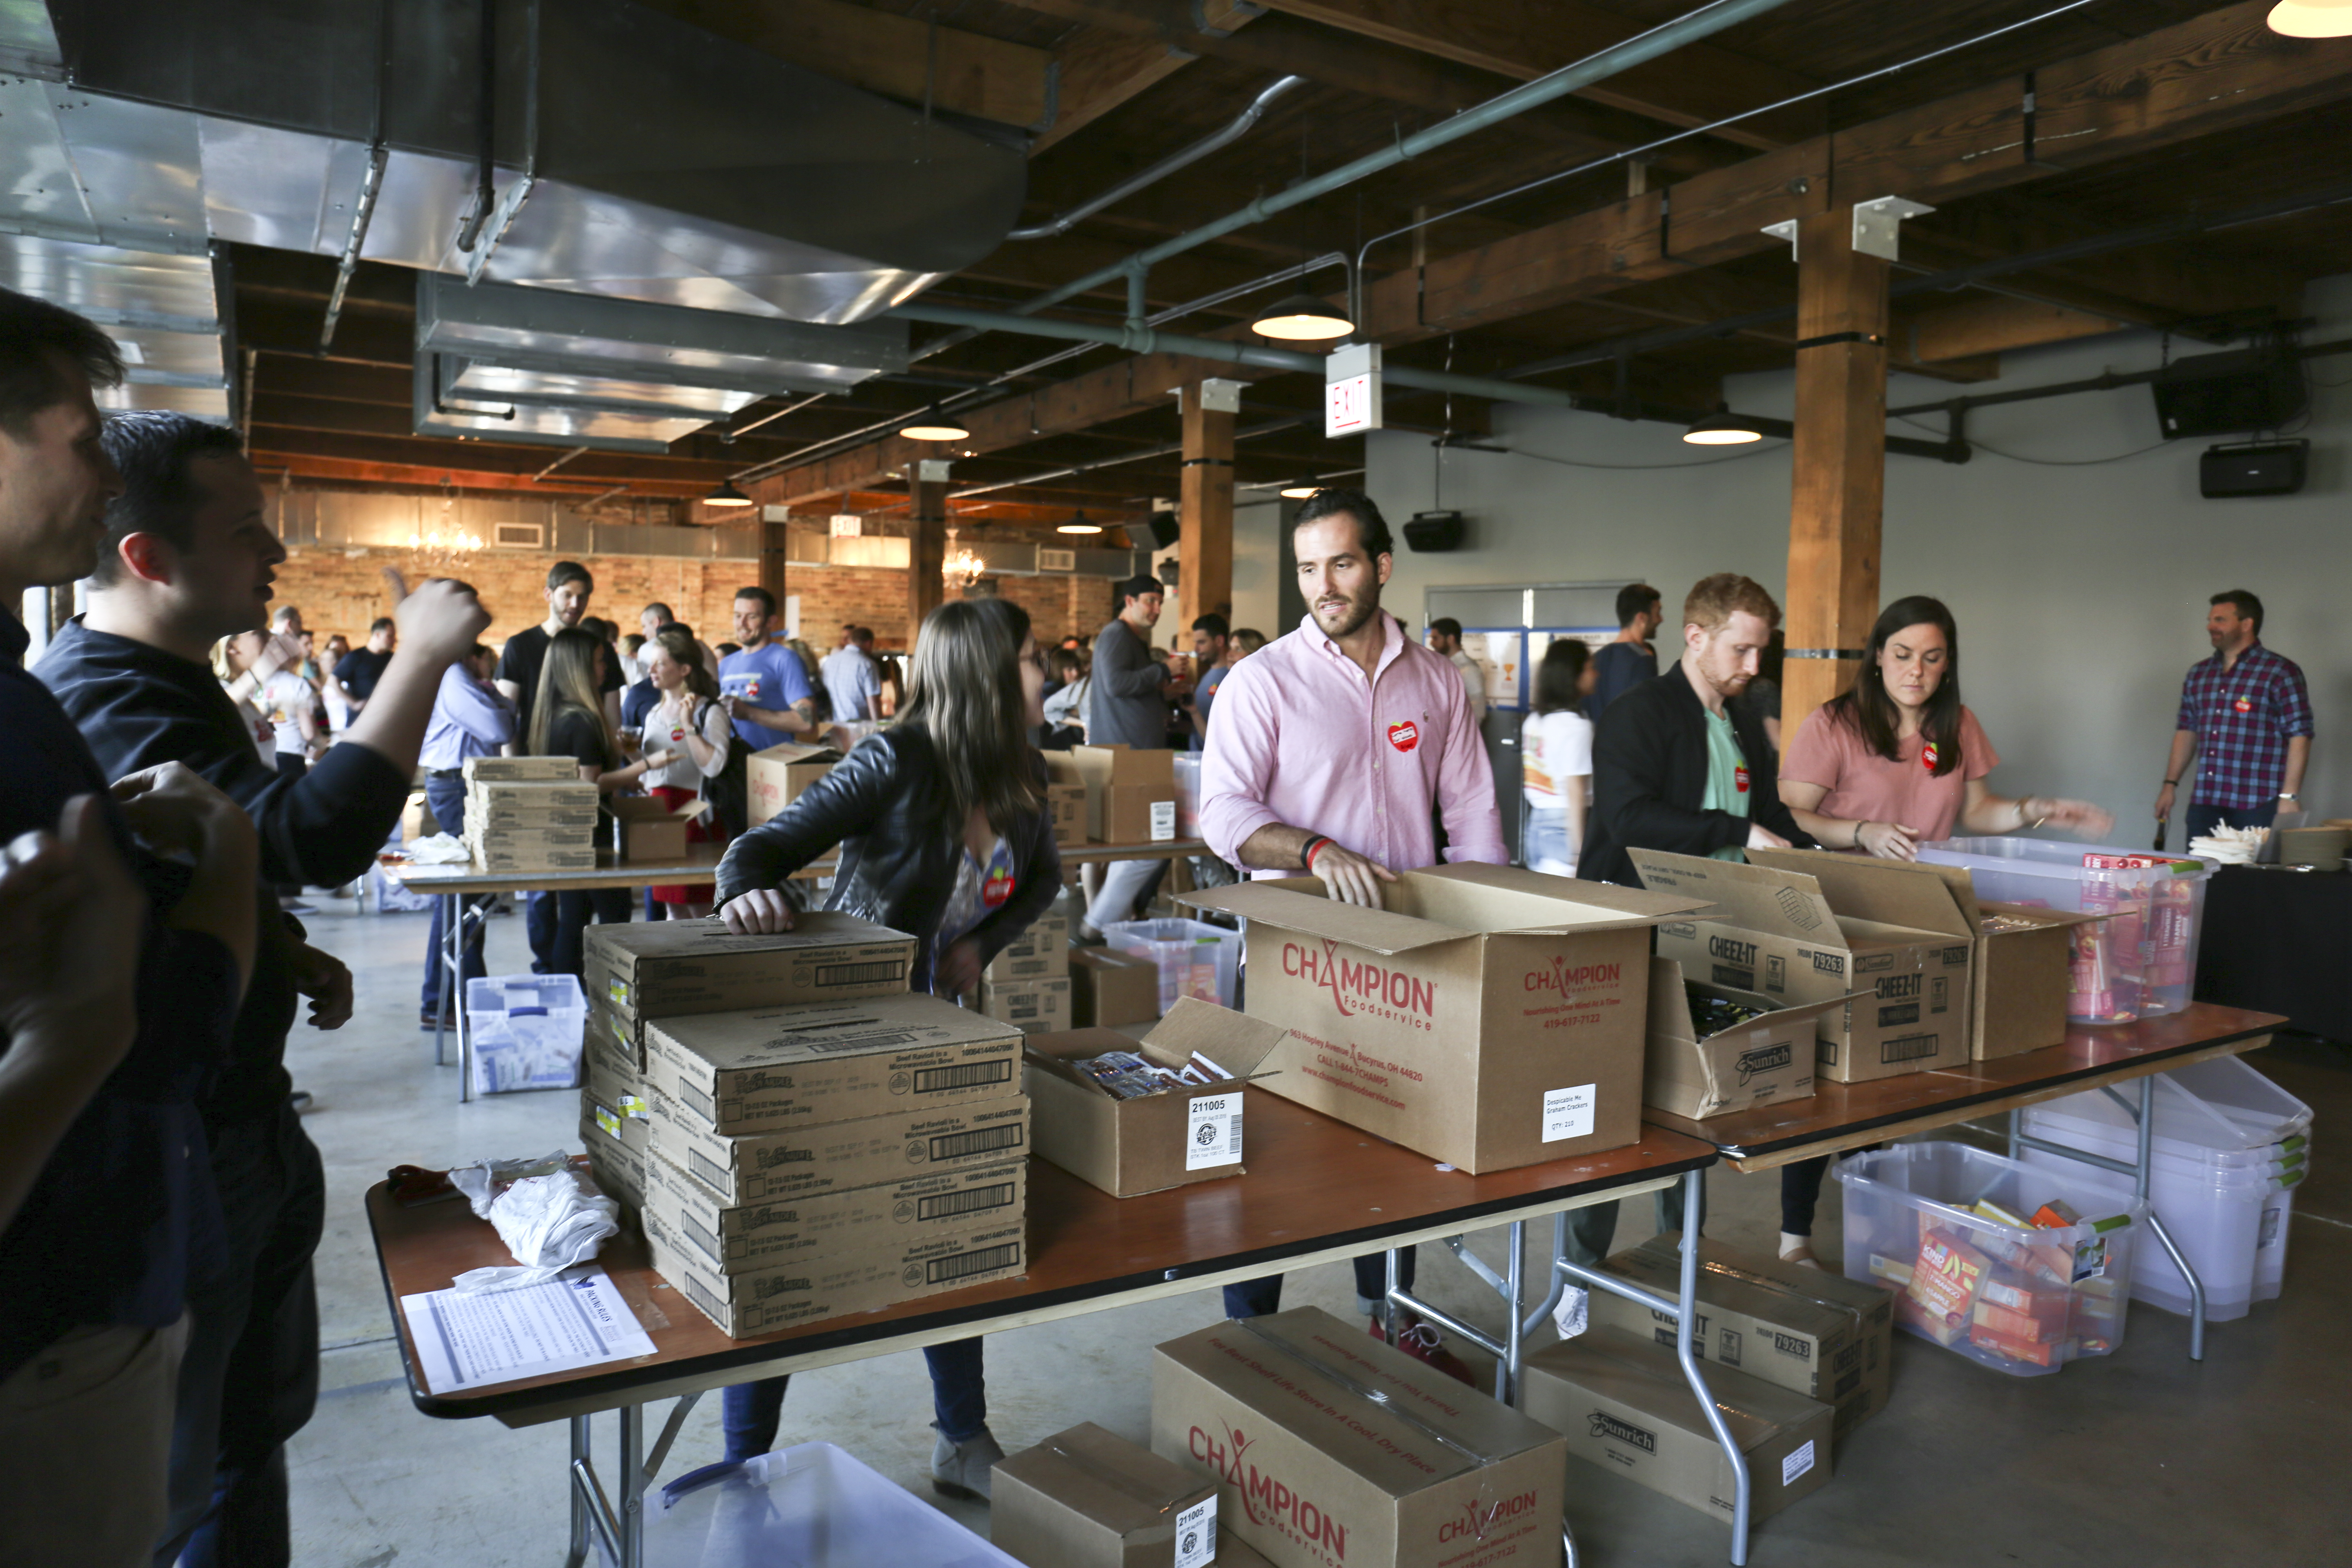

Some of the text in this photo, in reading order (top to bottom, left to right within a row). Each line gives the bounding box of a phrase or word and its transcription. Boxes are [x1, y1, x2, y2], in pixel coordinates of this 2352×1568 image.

[1334, 380, 1363, 419] EXIT
[1709, 935, 1757, 964] CHEEZ-IT
[1944, 947, 1967, 963] 79263
[1815, 953, 1843, 972] 79263
[1282, 938, 1433, 1017] CHAMPION
[1524, 956, 1620, 999] CHAMPION
[1875, 973, 1923, 1000] CHEEZ-IT
[1344, 996, 1431, 1031] Foodservice
[1523, 1006, 1559, 1016] Nourishing
[1575, 1002, 1590, 1010] Mind
[1544, 1013, 1601, 1029] 419-617-7122
[912, 1051, 935, 1060] Ravioli
[961, 1043, 1014, 1056] 10064144047090
[1290, 1028, 1423, 1082] 963 Hopley Avenue Bucyrus, OH 44820
[1746, 1047, 1788, 1071] Sunrich
[889, 1056, 954, 1070] Microwaveable Bowl
[1317, 1054, 1388, 1087] CALL 1-844-7CHAMPS
[745, 1076, 795, 1094] BOYARDEE
[1302, 1065, 1405, 1110] www.championfoodservice.com
[1192, 1100, 1225, 1113] 211005
[1547, 1096, 1573, 1106] Despicable
[905, 1123, 967, 1139] Microwaveable Bowl
[911, 1122, 925, 1131] Beef
[927, 1119, 948, 1128] Ravioli
[1552, 1123, 1563, 1131] QTY:
[1196, 1131, 1217, 1142] BEST
[893, 1183, 958, 1199] Microwaveable Bowl
[900, 1182, 915, 1191] Beef
[916, 1178, 938, 1187] Ravioli
[748, 1210, 800, 1230] BOYARDEE
[902, 1245, 964, 1263] Microwaveable Bowl
[909, 1245, 923, 1255] Beef
[924, 1241, 945, 1251] Ravioli
[1923, 1244, 1945, 1264] KIND
[1934, 1278, 1960, 1298] MANGO
[584, 1290, 605, 1308] PACKING
[596, 1308, 613, 1322] RULES
[1756, 1327, 1773, 1339] 24100
[1777, 1334, 1810, 1356] 79263
[1311, 1334, 1461, 1417] Thank You For Your Business
[1207, 1337, 1437, 1474] For Best Shelf Life Store In A Cool, Dry Place
[1601, 1417, 1653, 1449] Sunrich
[1189, 1415, 1345, 1561] CHAMPION
[1178, 1506, 1204, 1527] 211005
[1439, 1491, 1536, 1543] CHAMPION
[1438, 1550, 1475, 1568] Nourishing
[1476, 1544, 1489, 1553] One
[1490, 1536, 1507, 1548] Mind
[1522, 1525, 1537, 1534] Time
[1461, 1544, 1517, 1568] 19-617-7122
